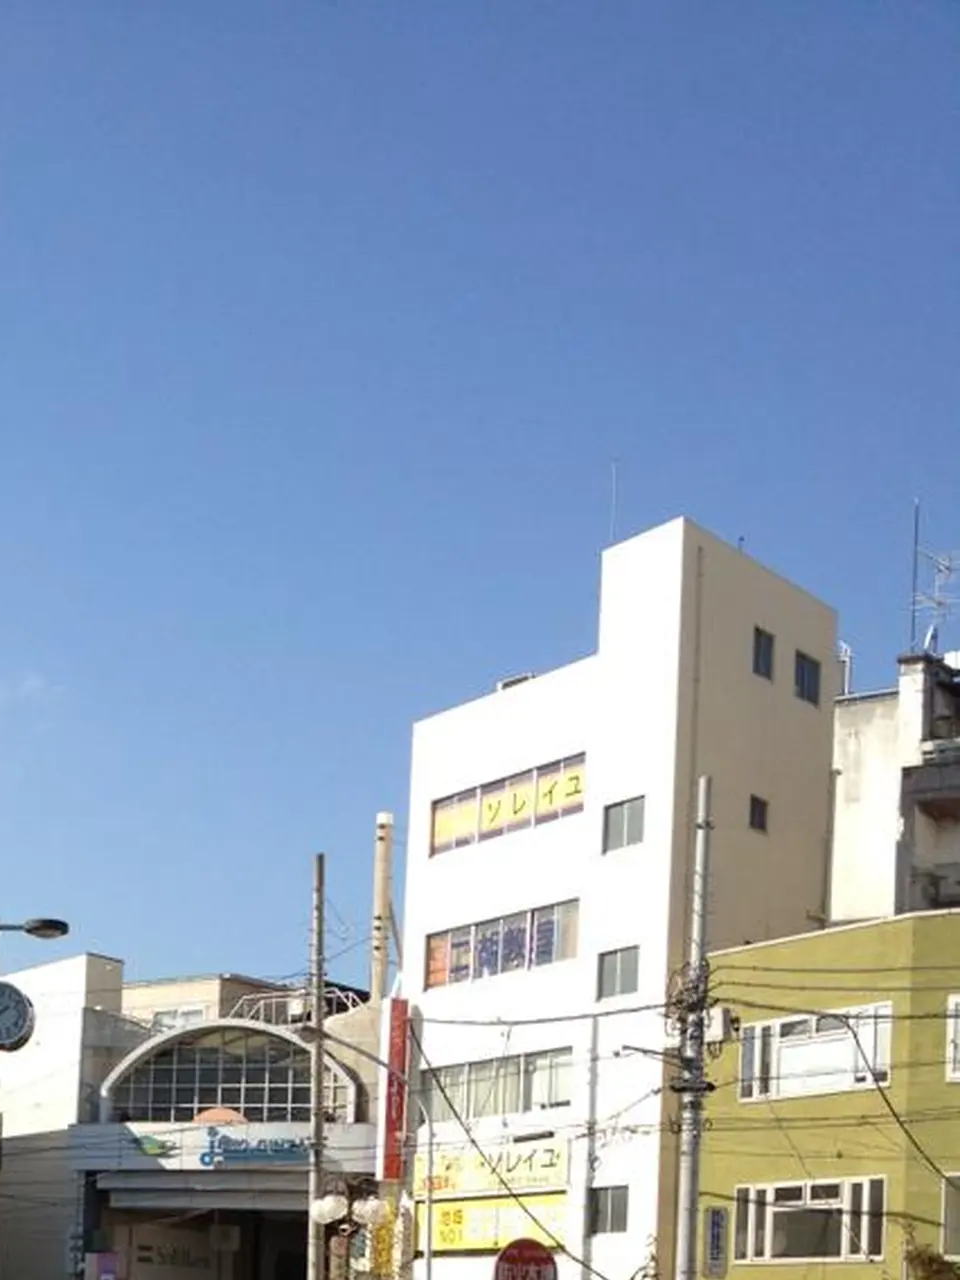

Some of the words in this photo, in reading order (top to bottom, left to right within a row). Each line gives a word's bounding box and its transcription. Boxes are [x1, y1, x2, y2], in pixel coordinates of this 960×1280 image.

[487, 774, 583, 824] ソレイユ
[488, 1148, 558, 1174] ソレイユ
